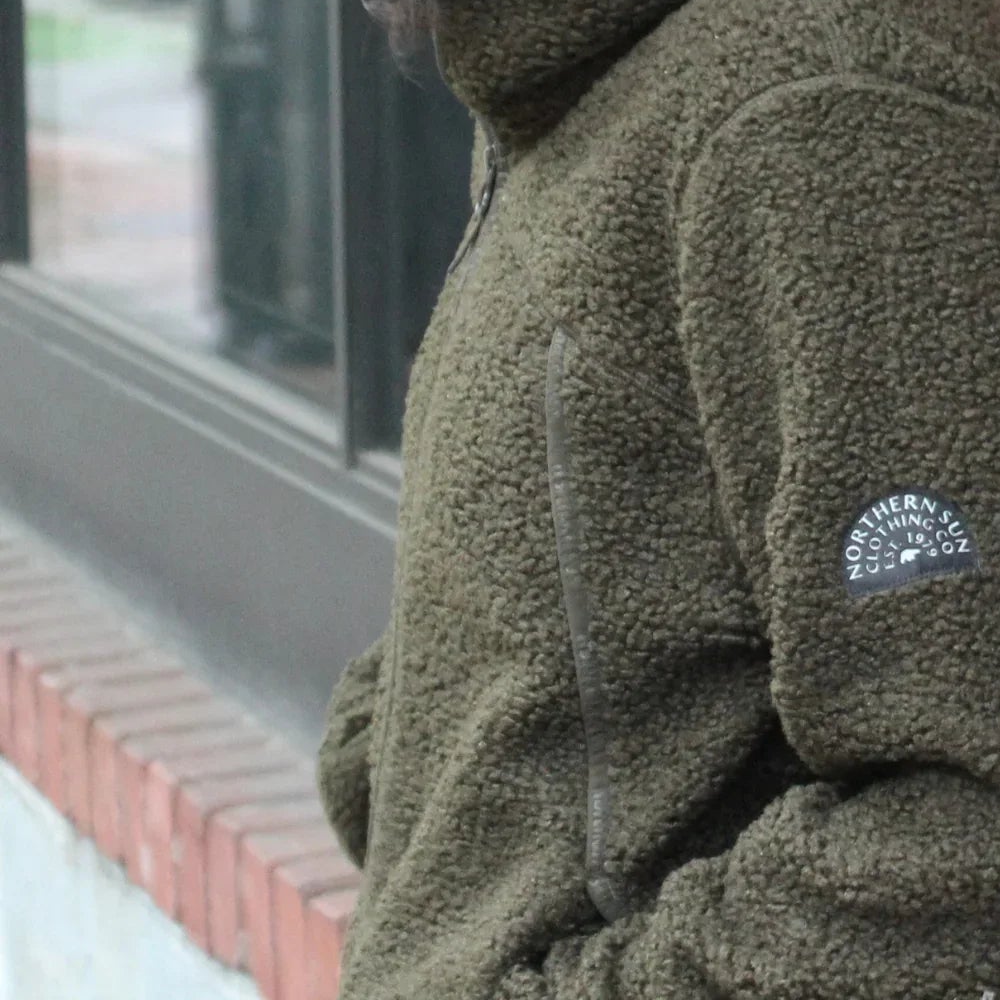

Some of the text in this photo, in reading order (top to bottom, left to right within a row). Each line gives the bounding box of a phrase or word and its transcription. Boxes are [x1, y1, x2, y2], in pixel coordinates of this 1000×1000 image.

[846, 494, 970, 580] NORTHERN SUN
[866, 514, 954, 574] CLOTHING CO
[906, 532, 938, 557] 1979
